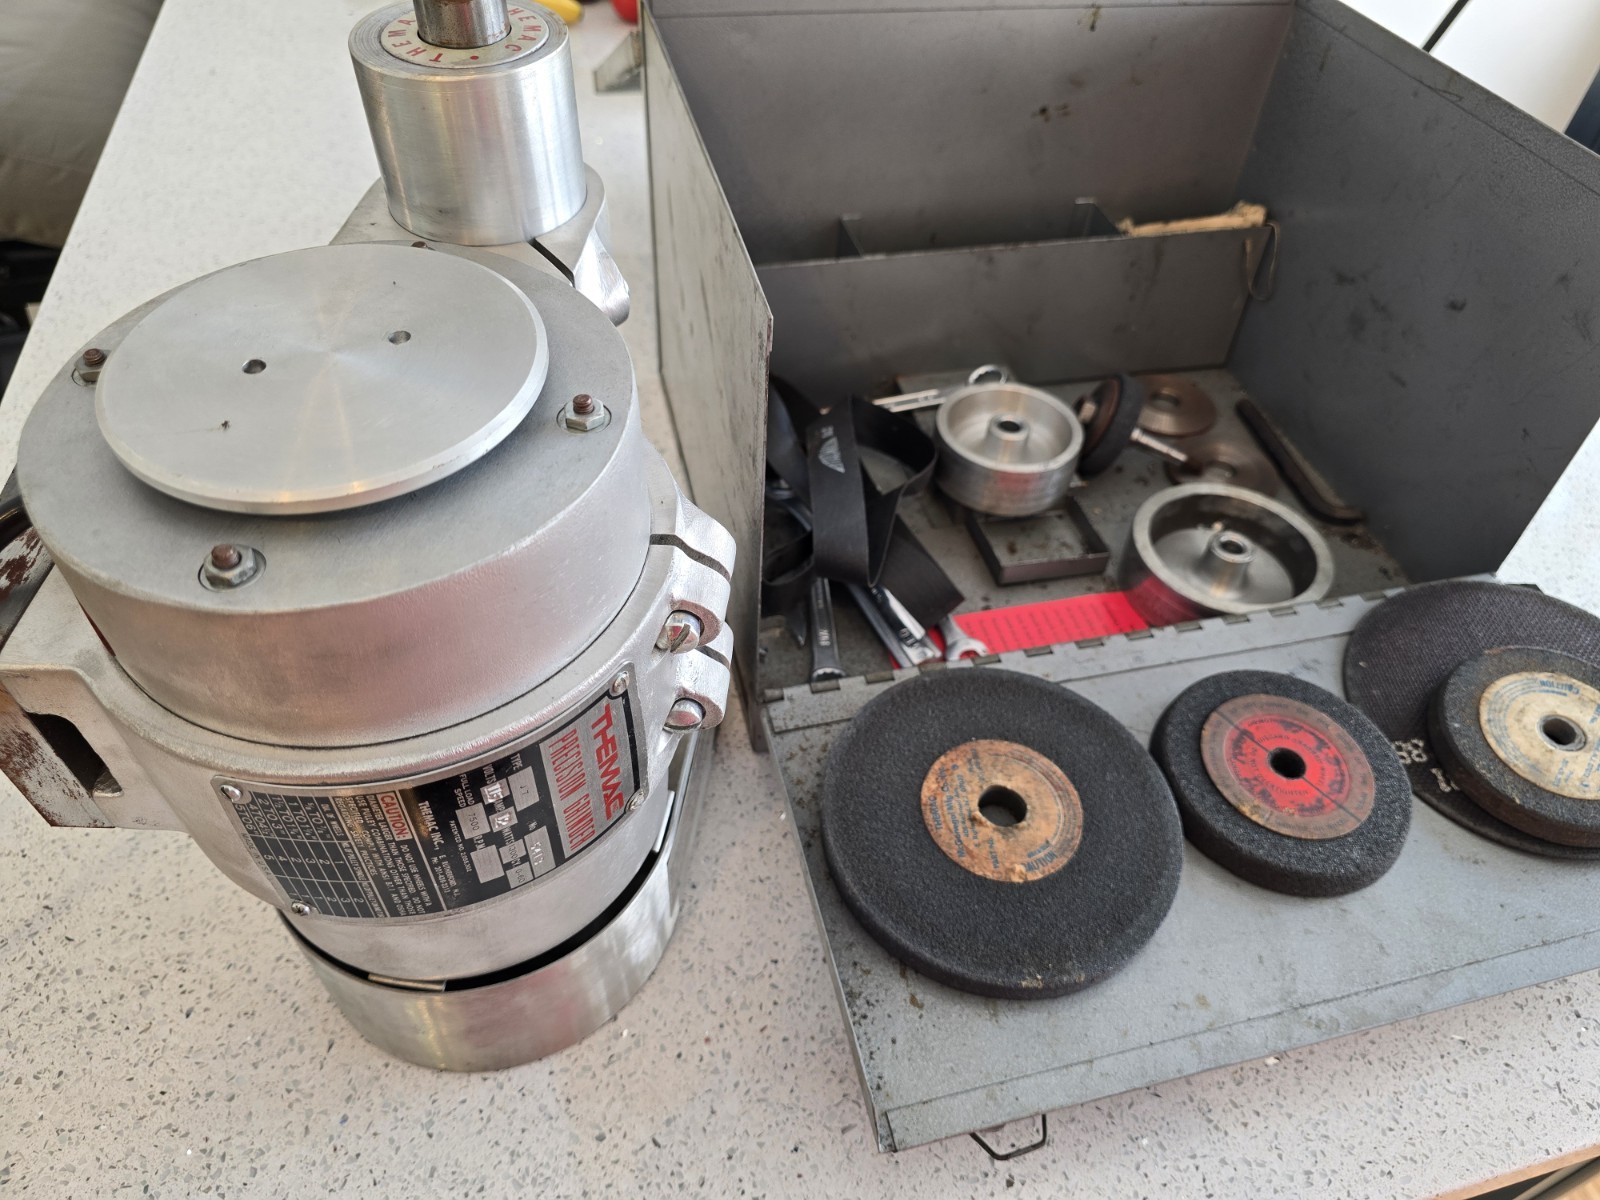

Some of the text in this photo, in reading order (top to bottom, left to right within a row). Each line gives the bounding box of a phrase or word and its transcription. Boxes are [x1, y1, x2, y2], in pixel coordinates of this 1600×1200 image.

[388, 18, 442, 63] THEMA
[505, 8, 542, 52] HEMAC
[510, 753, 523, 771] TYPE
[589, 703, 625, 820] THEMAC
[458, 773, 474, 805] FULL LOAD
[482, 763, 496, 784] VOLTS
[500, 826, 514, 845] WATTS
[548, 728, 595, 852] PRECISION GRINDER
[263, 808, 279, 820] TO
[277, 810, 293, 822] TO
[292, 810, 307, 822] TO
[308, 812, 323, 823] TO
[334, 797, 354, 827] REGARDING
[350, 830, 365, 848] SAFETY
[379, 794, 410, 838] CAUTION:
[418, 800, 438, 831] THEMAC
[453, 787, 466, 807] SPEED
[467, 812, 479, 831] 7500
[927, 795, 944, 829] THEMAC
[240, 832, 255, 851] MADE
[329, 821, 344, 836] WHEELS
[448, 819, 461, 842] PATENTED
[346, 853, 359, 866] PULLEY
[354, 796, 416, 914] USE PULLEY COMBINATIONS OTHER THAN THOSE
[366, 795, 384, 820] DIAMETER
[378, 822, 393, 840] LARGER
[387, 842, 399, 855] THAN
[394, 857, 406, 871] THOSE
[415, 904, 425, 913] NOT
[403, 852, 414, 863] NOT
[408, 864, 418, 872] USE
[361, 830, 376, 851] COMPLY
[371, 852, 384, 866] WITH
[378, 867, 390, 880] ANSI
[390, 893, 401, 903] AND
[396, 904, 407, 915] OSHA
[412, 873, 425, 890] WHEELS
[420, 891, 430, 902] WITH
